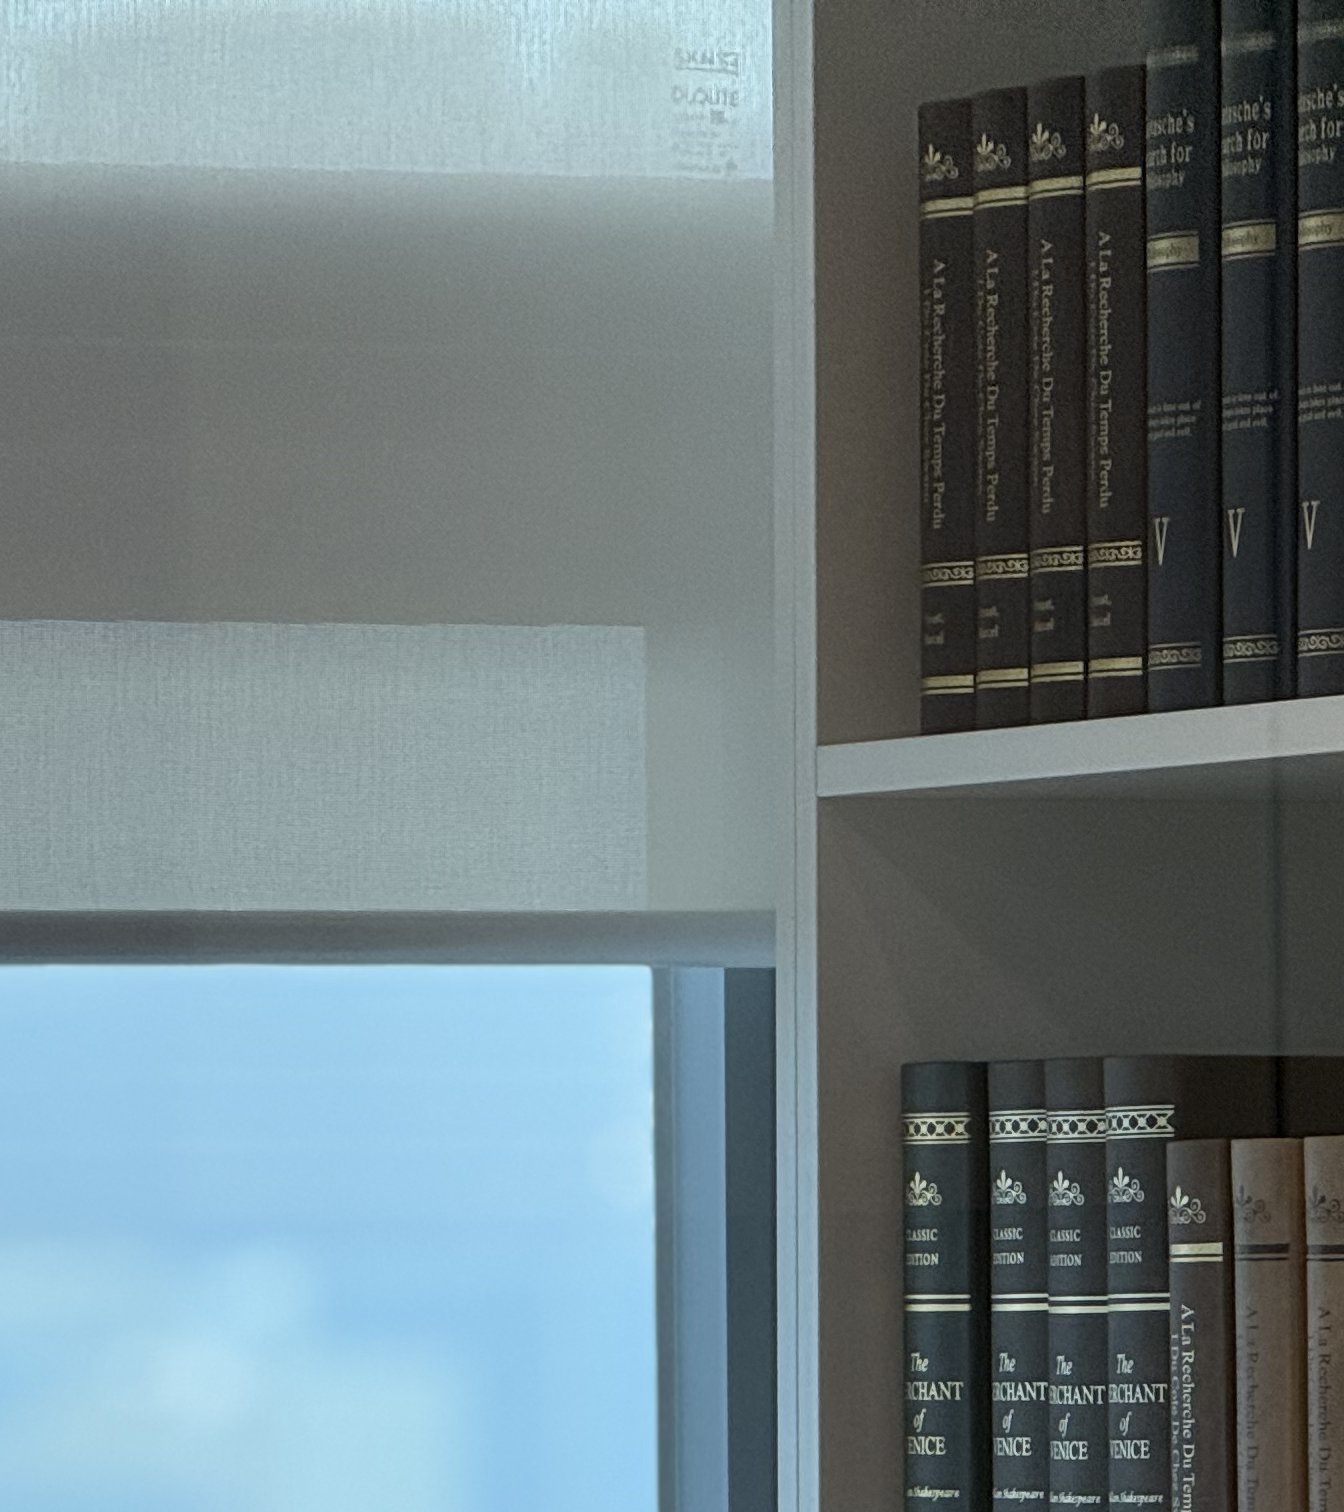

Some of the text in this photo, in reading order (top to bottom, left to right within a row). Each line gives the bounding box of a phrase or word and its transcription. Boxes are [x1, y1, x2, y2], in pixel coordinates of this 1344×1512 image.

[1181, 1304, 1195, 1320] A
[1181, 1322, 1195, 1345] La
[911, 1353, 928, 1372] The
[999, 1353, 1016, 1372] The
[1056, 1356, 1072, 1375] The
[1117, 1354, 1133, 1374] The
[1182, 1350, 1195, 1438] Recherche
[913, 1409, 926, 1432] of
[1002, 1409, 1014, 1433] of
[1059, 1412, 1071, 1436] of
[1120, 1411, 1132, 1436] of
[1183, 1445, 1195, 1469] Du
